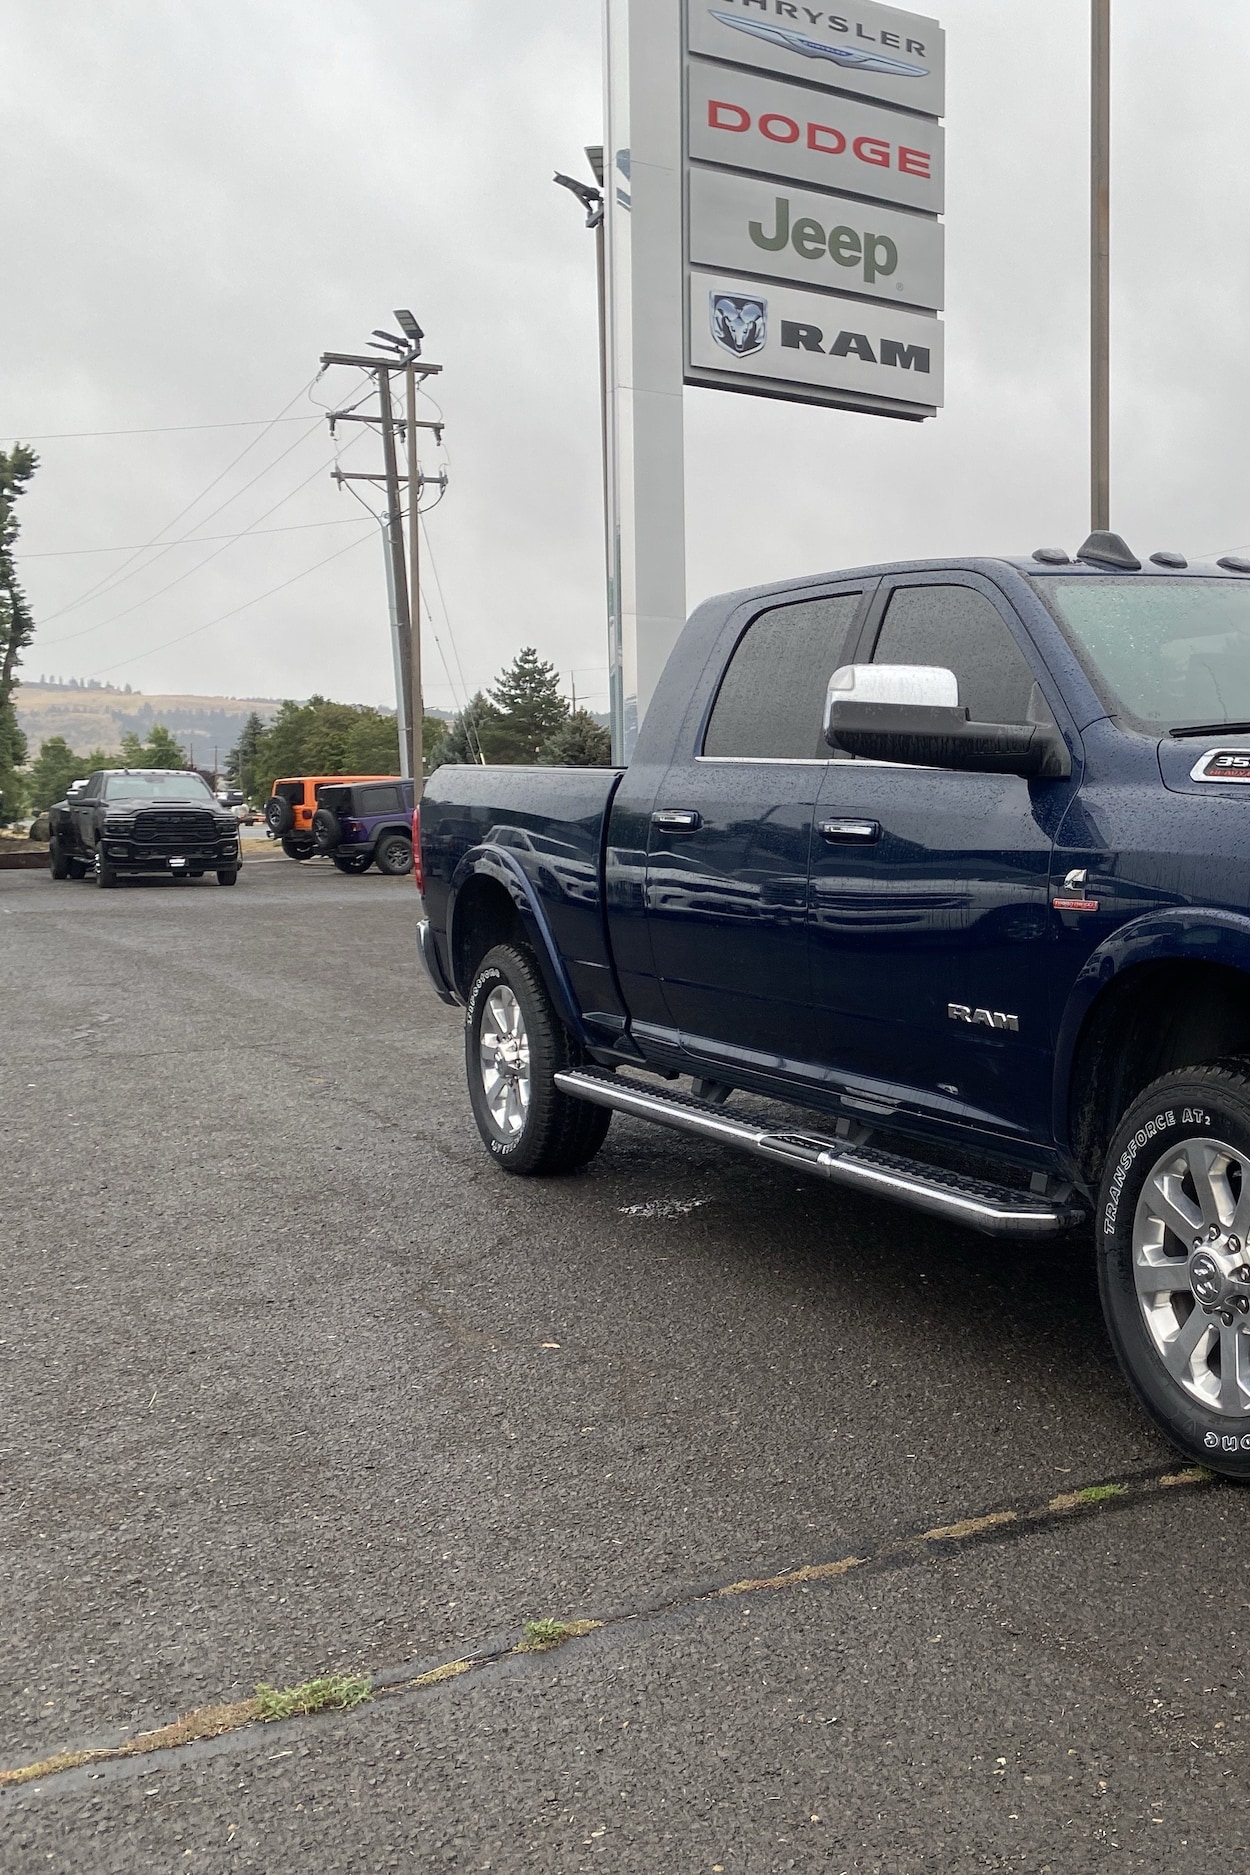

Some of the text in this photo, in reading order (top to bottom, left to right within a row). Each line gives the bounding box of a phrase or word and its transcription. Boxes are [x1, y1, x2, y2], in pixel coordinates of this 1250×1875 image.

[722, 0, 926, 57] HRYSLER
[707, 99, 931, 179] DODGE
[748, 197, 898, 283] Jeep
[780, 319, 931, 374] RAM
[947, 1003, 1019, 1031] RAM
[1103, 1110, 1176, 1235] TRANSFORCE
